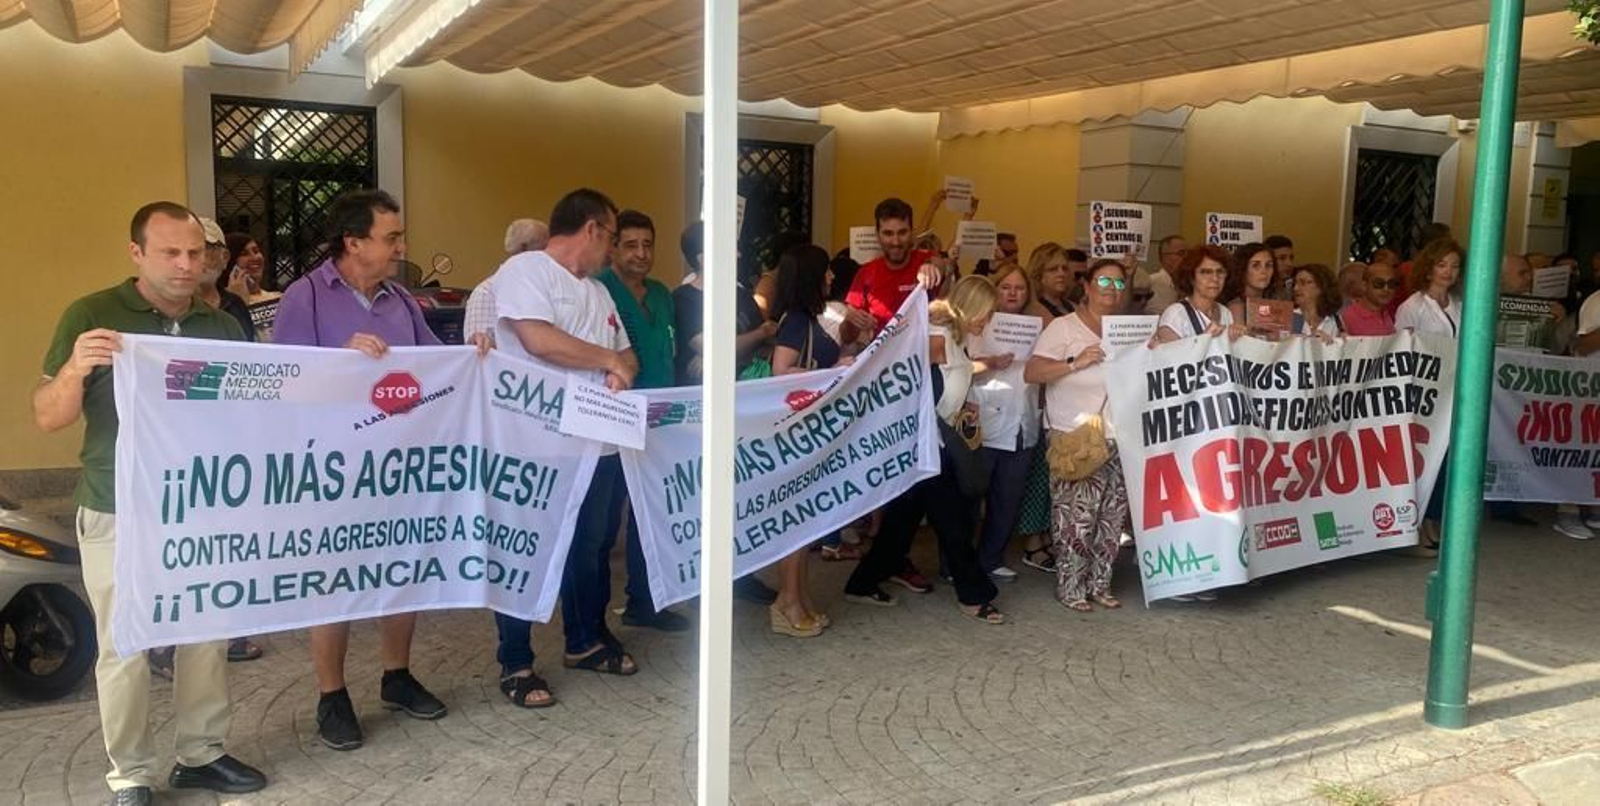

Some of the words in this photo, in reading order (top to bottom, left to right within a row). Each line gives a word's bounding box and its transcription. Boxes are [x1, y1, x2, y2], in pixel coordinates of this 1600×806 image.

[229, 362, 300, 378] SINDICATO
[374, 386, 418, 399] STOP
[363, 413, 387, 426] LAS
[162, 454, 253, 524] ¡¡NO
[264, 439, 346, 504] MÁS
[736, 494, 765, 521] LAS
[767, 449, 848, 509] AGRESIONES
[849, 444, 861, 464] A
[163, 532, 261, 569] CONTRA
[268, 528, 312, 559] LAS
[316, 516, 447, 555] AGRESIONES
[451, 515, 467, 541] A
[1266, 524, 1291, 542] CCOO
[153, 556, 447, 623] ¡¡TOLERANCIA
